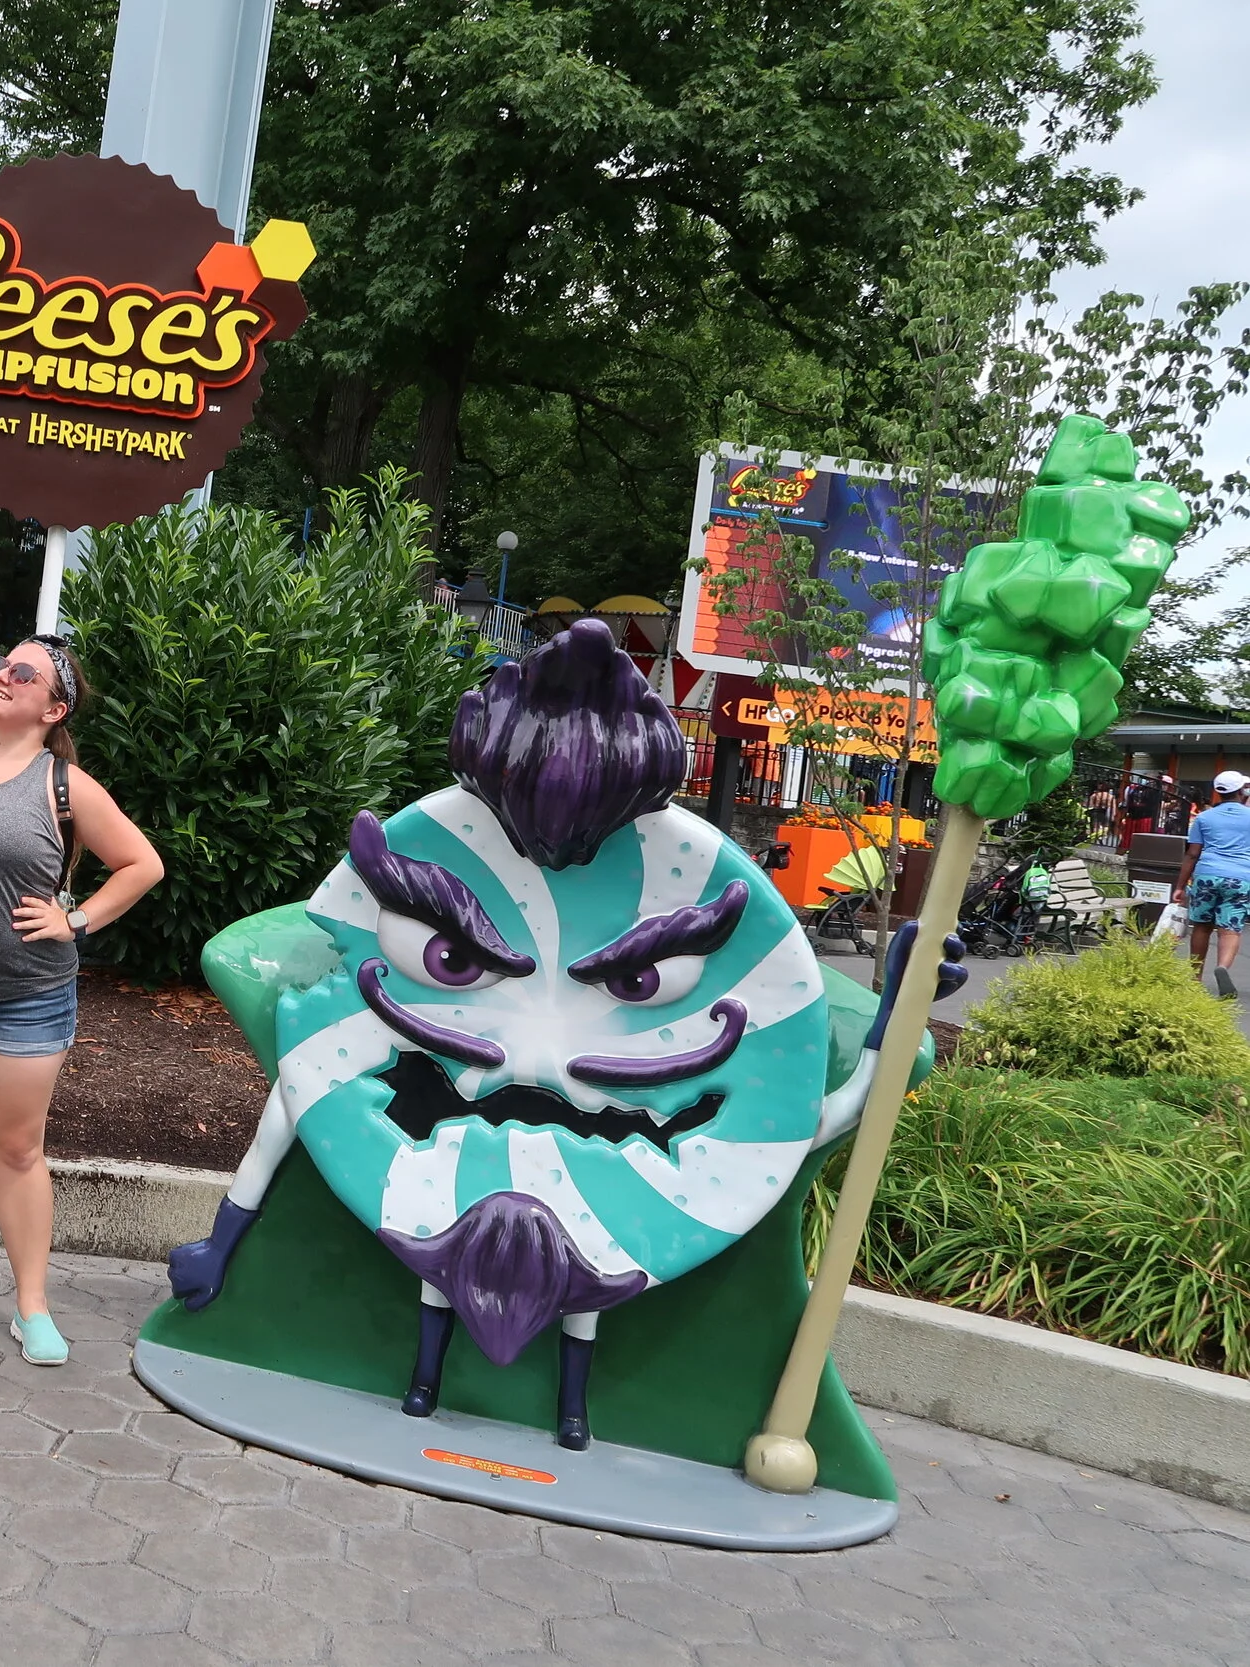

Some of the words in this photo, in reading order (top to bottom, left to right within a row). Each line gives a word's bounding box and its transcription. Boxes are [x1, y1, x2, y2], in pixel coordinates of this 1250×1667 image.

[27, 412, 187, 461] HERSHEYPARK
[744, 703, 796, 724] HPGO
[887, 713, 925, 733] Yor
